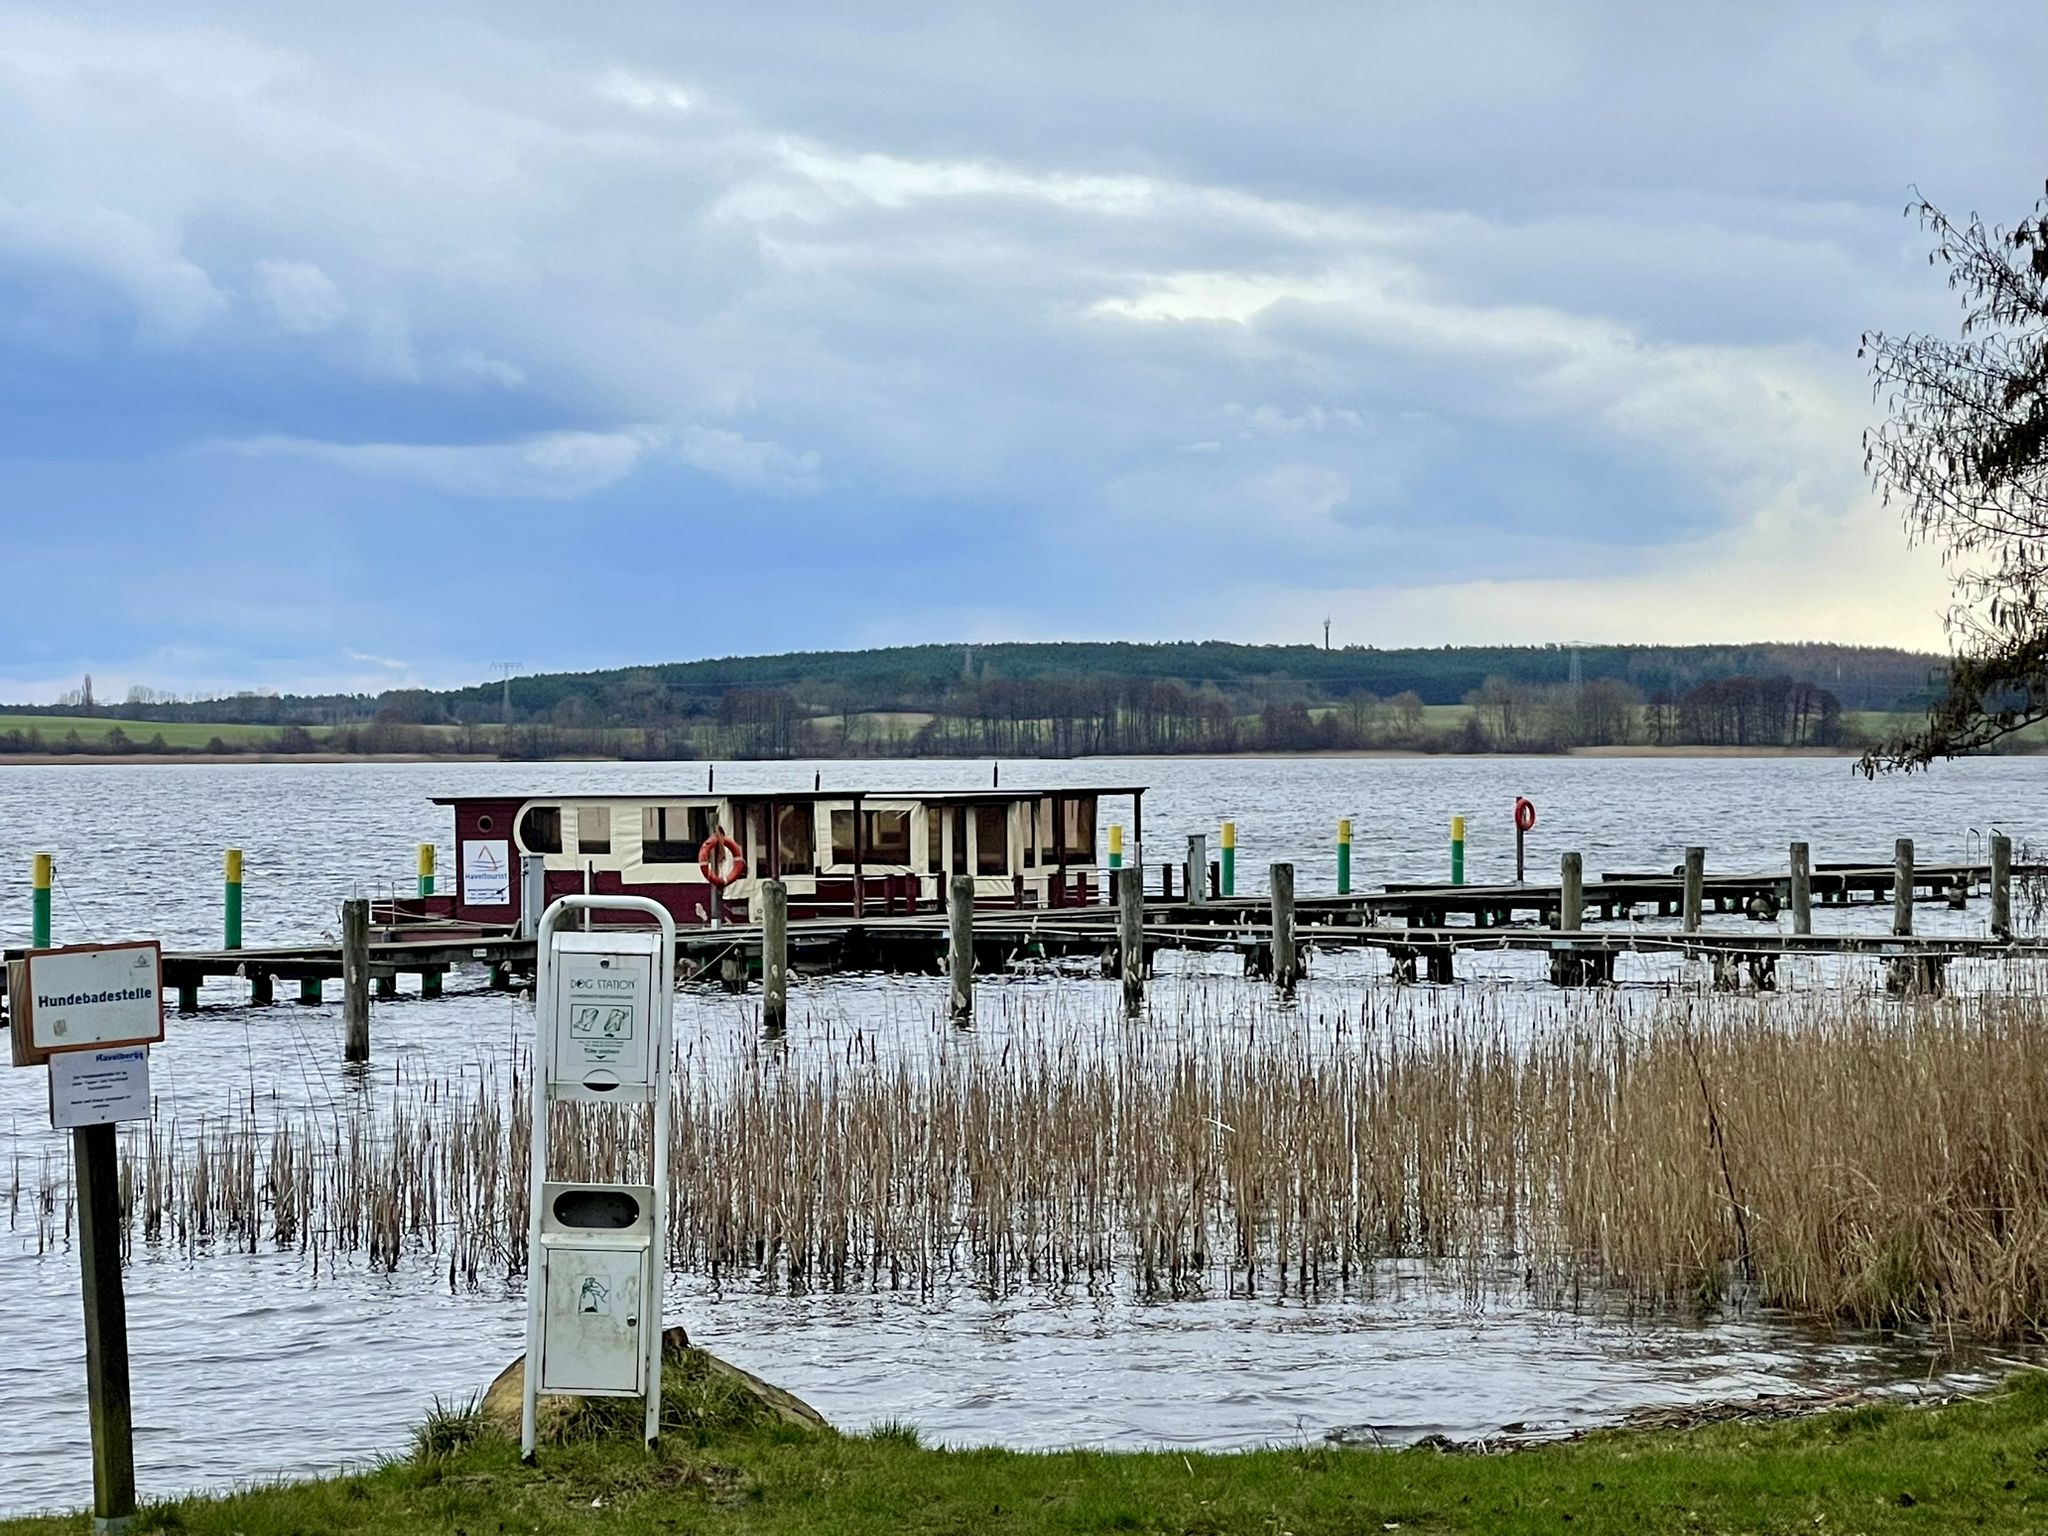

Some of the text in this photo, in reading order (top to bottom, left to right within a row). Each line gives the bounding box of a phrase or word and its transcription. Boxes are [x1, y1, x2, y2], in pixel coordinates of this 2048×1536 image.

[570, 979, 636, 990] DOG STATION
[38, 987, 152, 1008] Hundebadestelle
